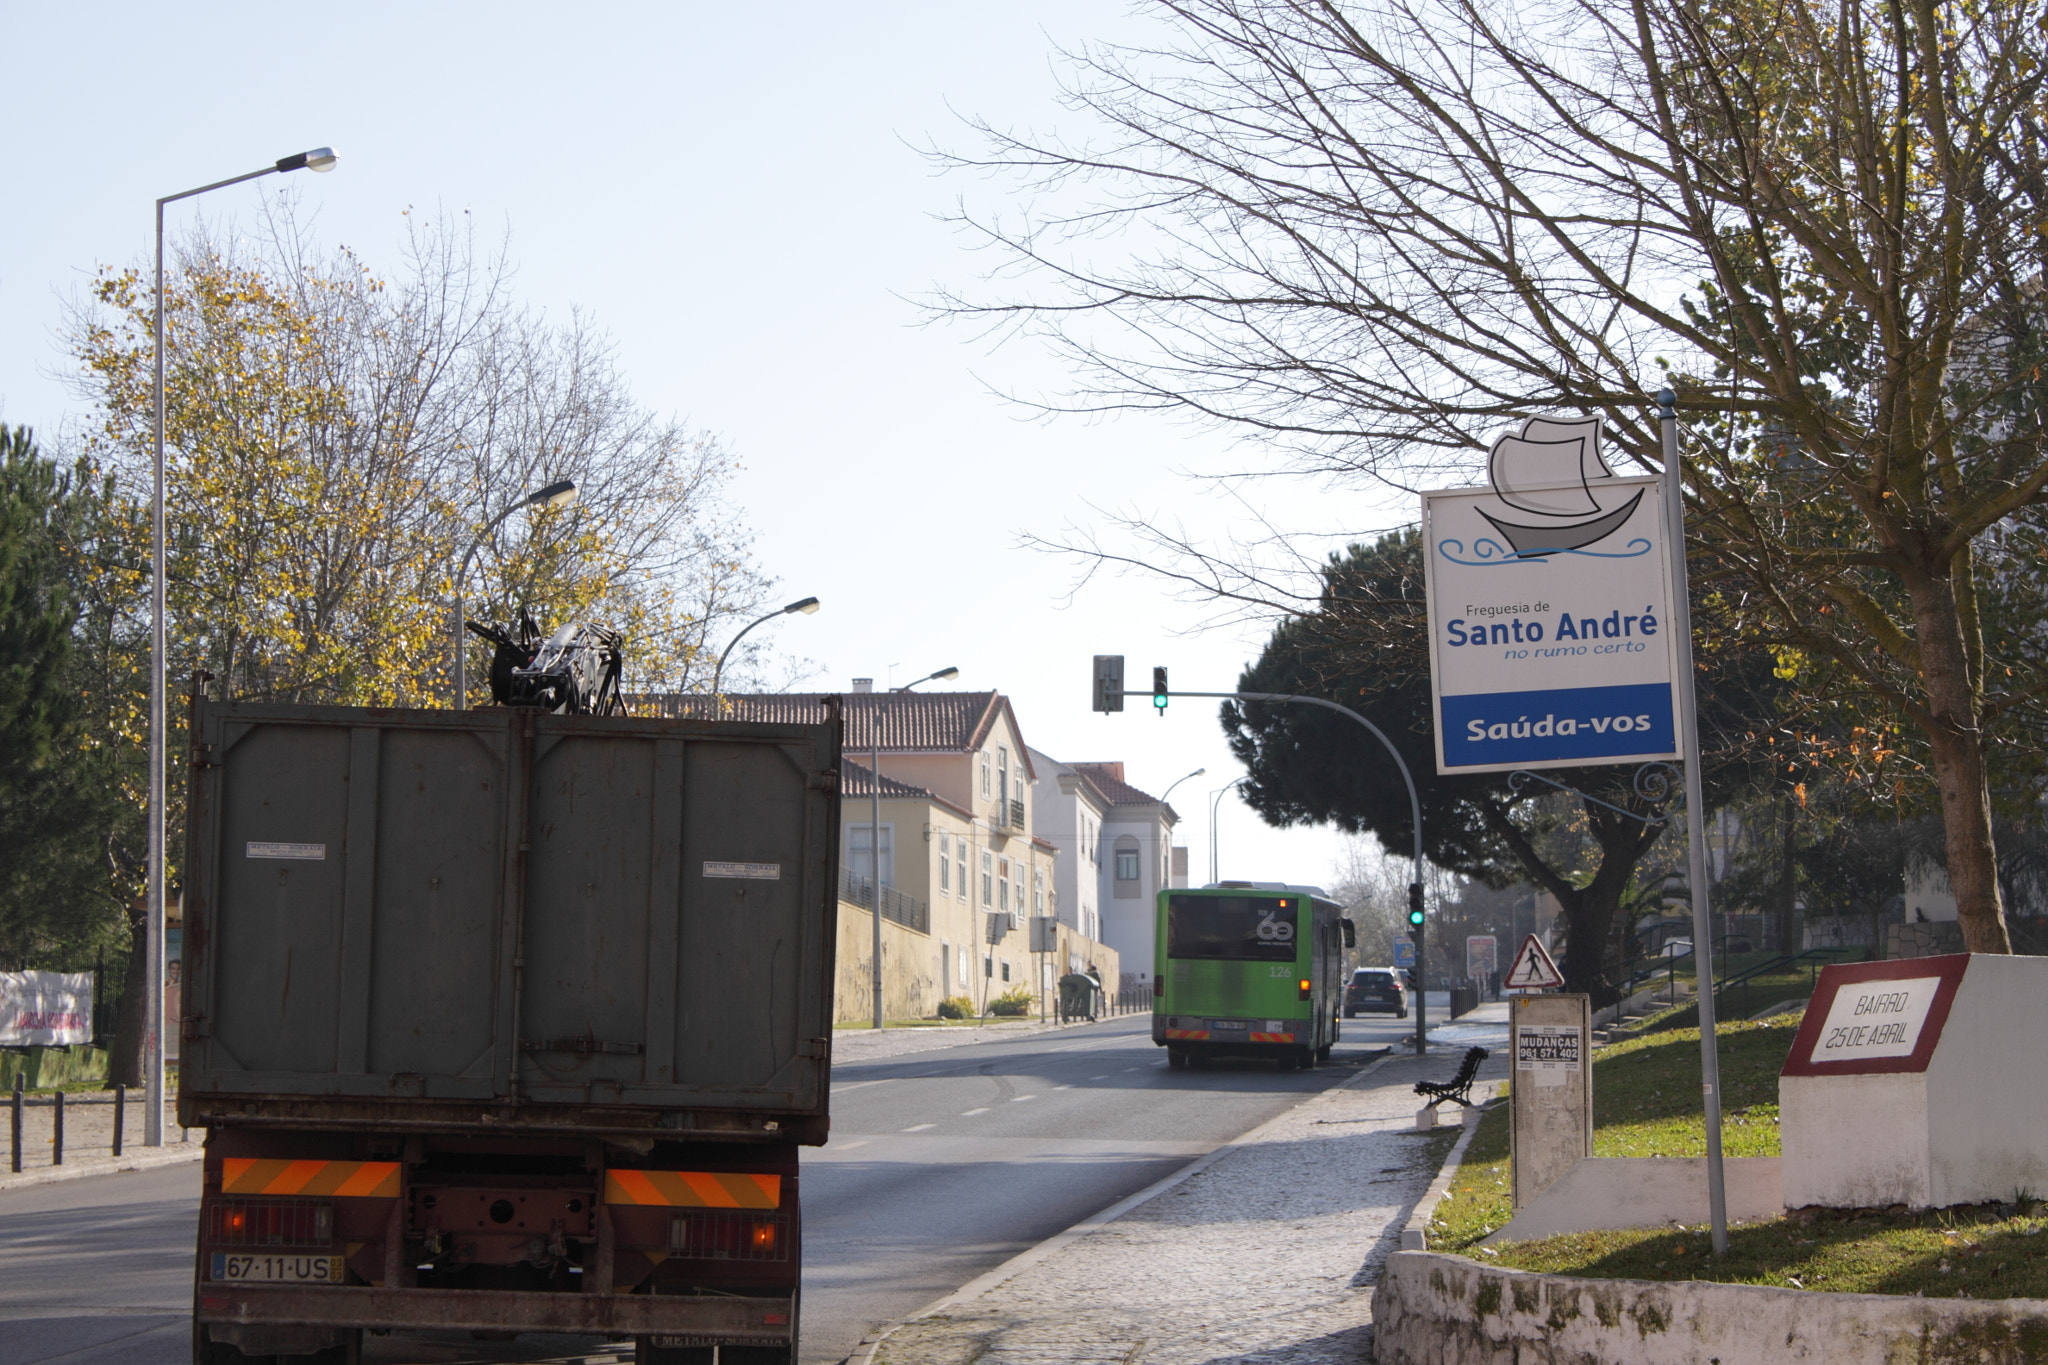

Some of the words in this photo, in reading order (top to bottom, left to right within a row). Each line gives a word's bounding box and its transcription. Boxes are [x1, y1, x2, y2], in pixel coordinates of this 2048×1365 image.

[1466, 603, 1530, 618] Freguesia
[1534, 601, 1550, 612] de
[1447, 618, 1544, 647] Santo
[1555, 605, 1658, 641] André
[1504, 649, 1528, 660] no
[1534, 645, 1588, 658] rumo
[1593, 640, 1646, 655] certo
[1467, 714, 1651, 742] Saúda-vos
[1256, 910, 1294, 941] 60
[1269, 966, 1292, 978] 126
[1854, 992, 1909, 1016] BAIRRO
[1520, 1037, 1578, 1050] MUDANÇAS
[1825, 1026, 1847, 1049] 25
[1847, 1025, 1871, 1047] DE
[1867, 1022, 1908, 1046] ABRIL
[1520, 1048, 1537, 1058] 961
[1540, 1048, 1557, 1058] 571
[1560, 1048, 1577, 1058] 402
